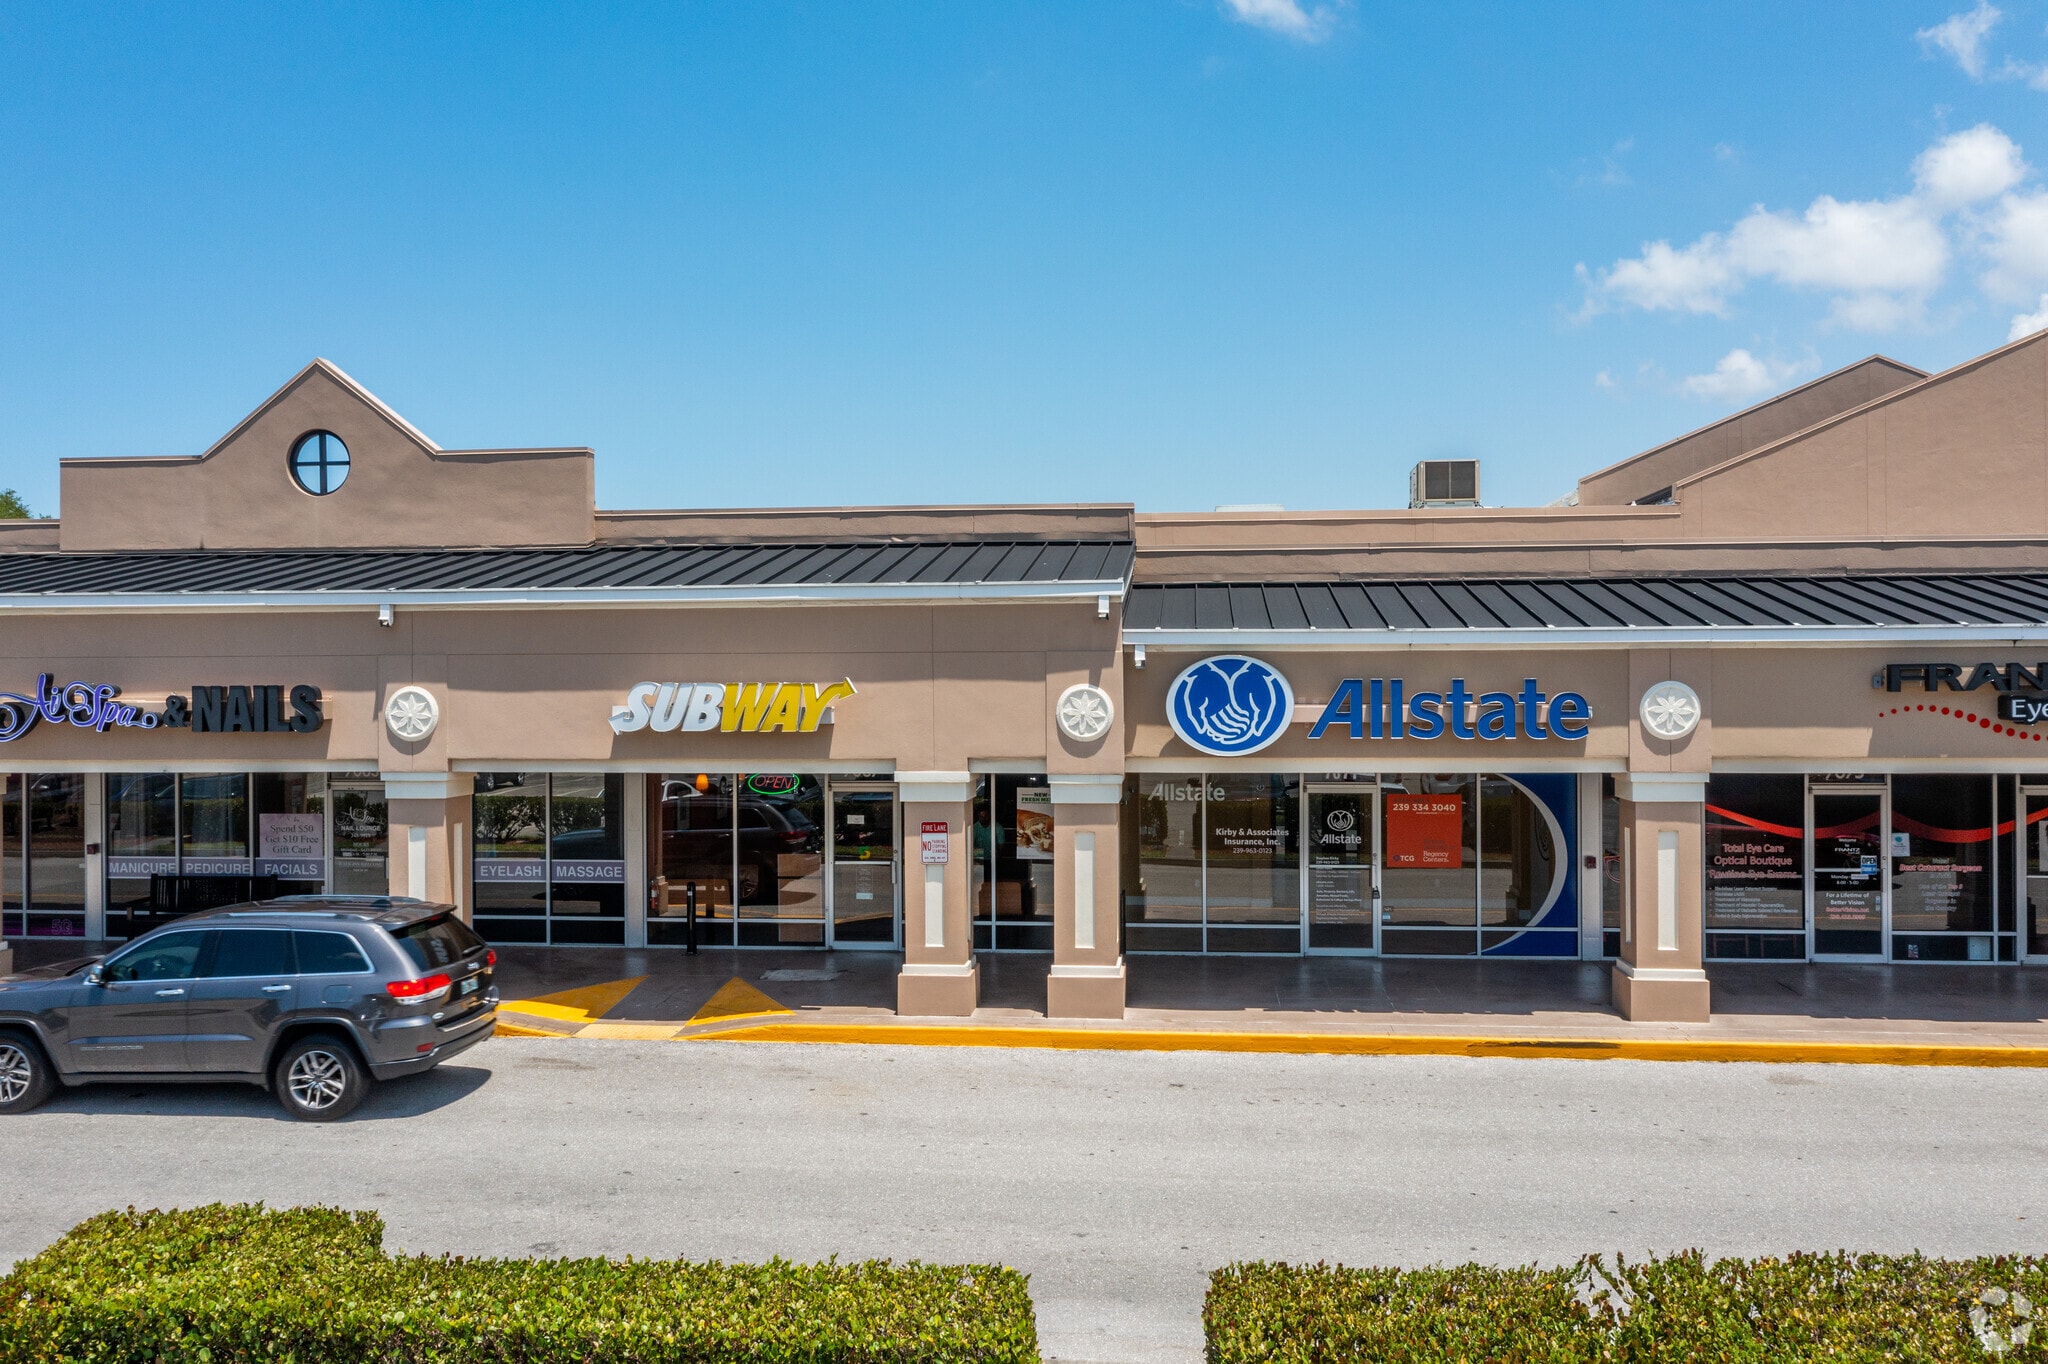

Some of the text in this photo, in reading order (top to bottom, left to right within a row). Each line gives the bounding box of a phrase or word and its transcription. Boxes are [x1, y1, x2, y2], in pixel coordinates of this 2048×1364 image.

[63, 681, 158, 732] Spa
[164, 684, 324, 733] & NAILS
[608, 677, 858, 736] SUBWAY
[1307, 677, 1590, 741] Allstate
[754, 775, 793, 789] OPEN
[1147, 783, 1226, 802] Allstate
[1393, 803, 1456, 812] 239 334 3040
[270, 824, 314, 834] Spend $50
[1215, 828, 1290, 837] Kirby & Associates
[265, 834, 319, 843] Get $10 Free
[1224, 838, 1265, 846] Insurance,
[1320, 833, 1361, 844] Allstate
[272, 845, 312, 854] Gift Card
[922, 840, 932, 851] NO
[1723, 843, 1785, 854] Total Eye Care
[1423, 850, 1449, 858] Regency
[1713, 855, 1793, 867] Optical Boutique
[109, 862, 176, 874] MANICURE
[185, 863, 250, 875] PEDICURE
[264, 863, 318, 875] FACIALS
[480, 865, 542, 878] EYELASH
[556, 865, 622, 878] MASSAGE
[51, 919, 73, 935] 5G
